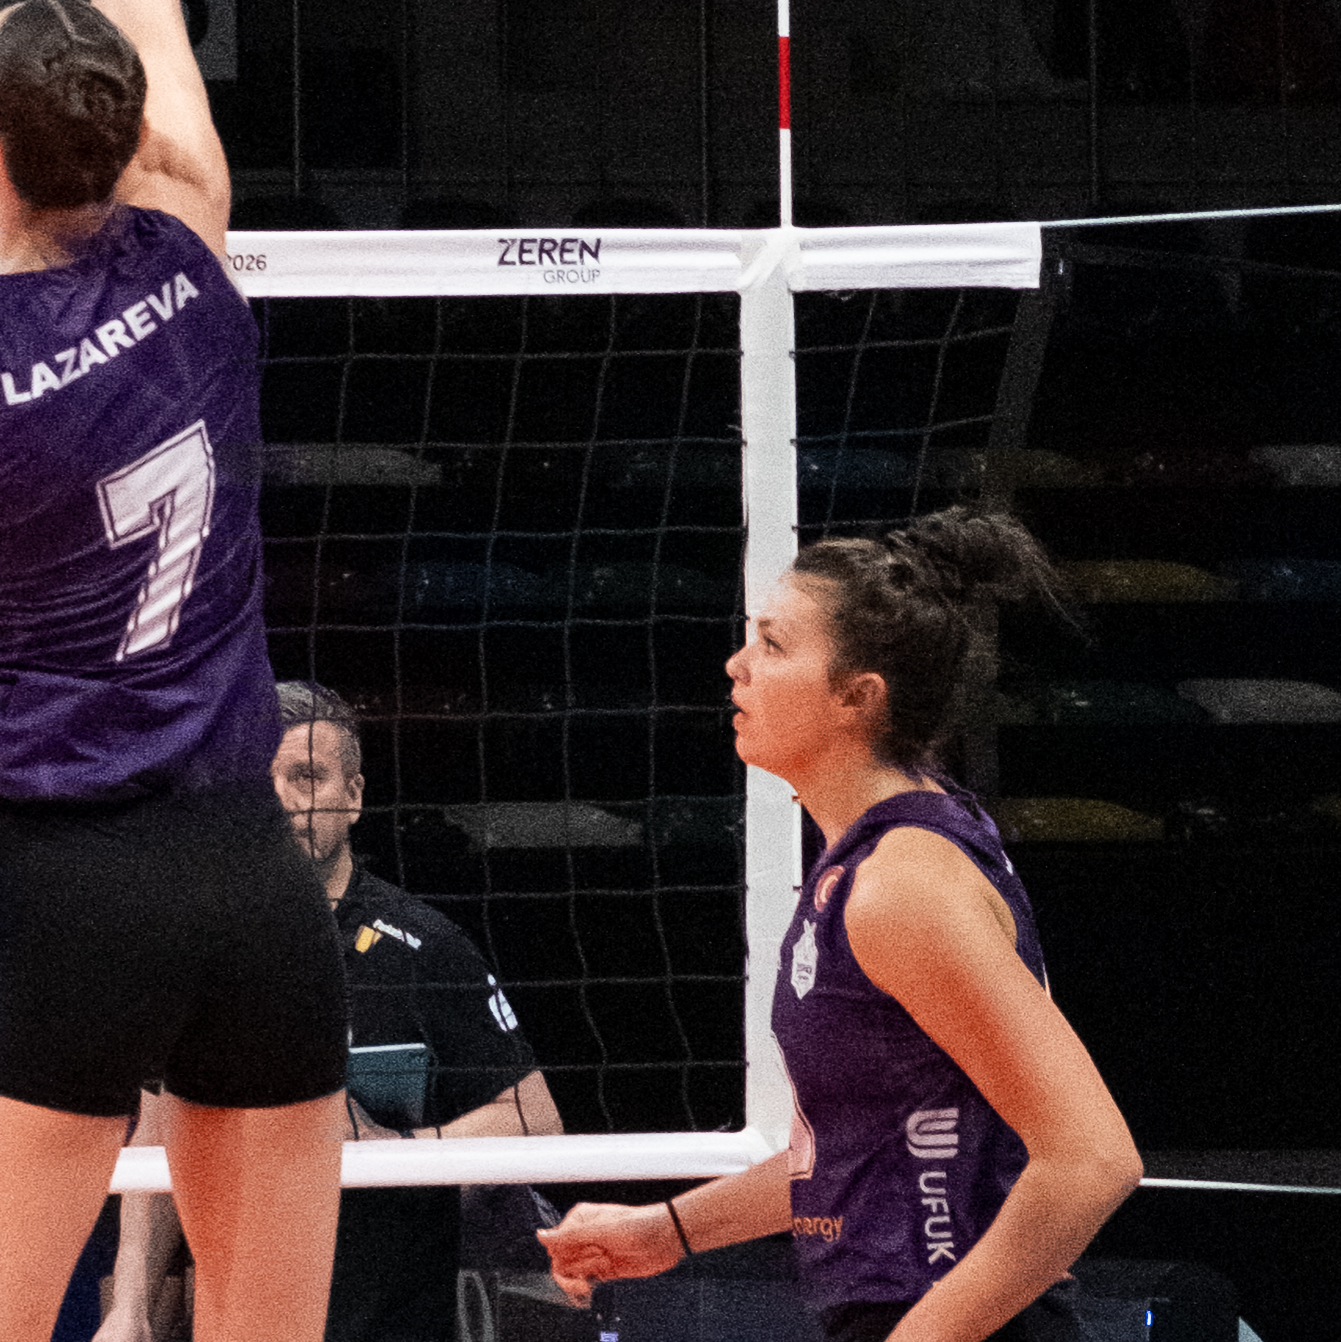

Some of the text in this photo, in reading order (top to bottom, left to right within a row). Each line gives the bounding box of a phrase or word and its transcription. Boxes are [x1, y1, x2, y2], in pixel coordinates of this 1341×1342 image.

[497, 237, 601, 266] ZEREN
[542, 269, 601, 284] GROUP
[1, 272, 200, 406] LAZAREVA
[96, 419, 215, 663] 7
[918, 1171, 956, 1265] UFUK
